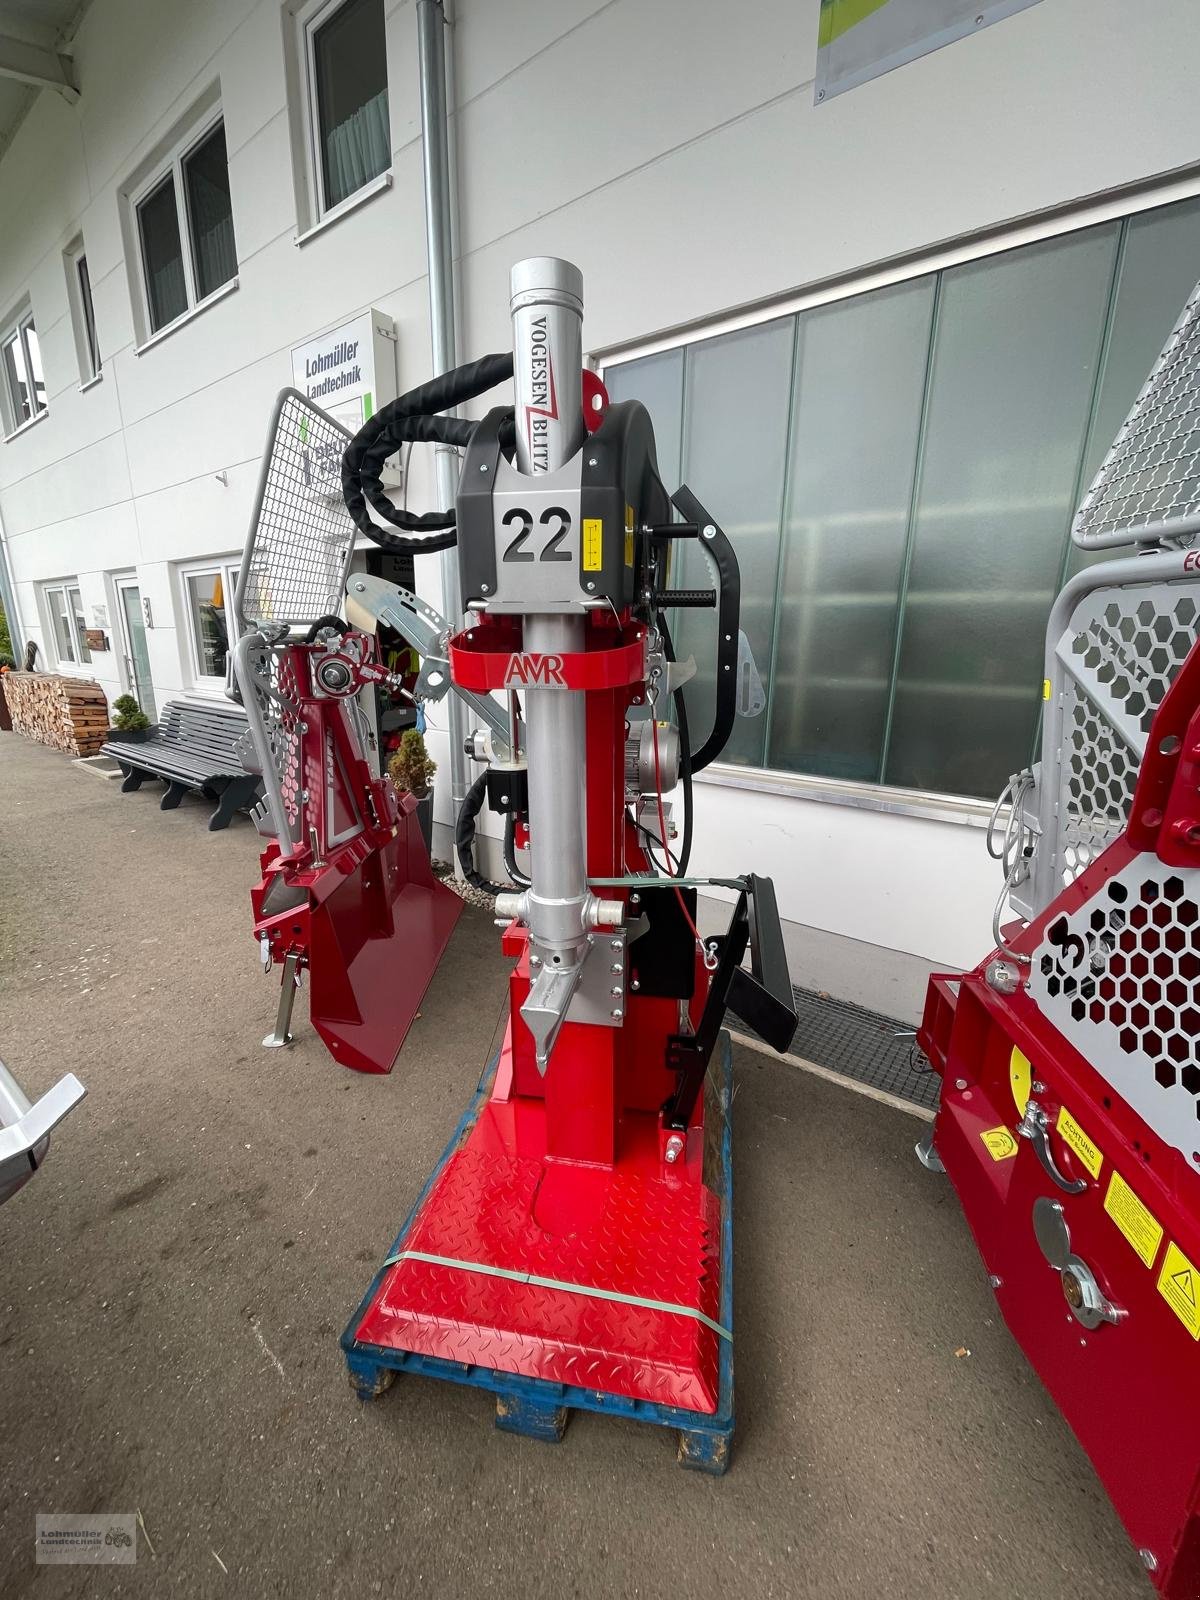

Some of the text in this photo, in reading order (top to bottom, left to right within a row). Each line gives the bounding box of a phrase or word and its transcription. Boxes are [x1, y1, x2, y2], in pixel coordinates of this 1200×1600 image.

[305, 340, 359, 379] Lohmüller
[306, 364, 362, 400] Landtechnik
[531, 316, 548, 472] VOGESEN BLITZ
[502, 506, 573, 563] 22
[505, 655, 564, 684] AMR
[1064, 1120, 1095, 1159] ACHTUNG
